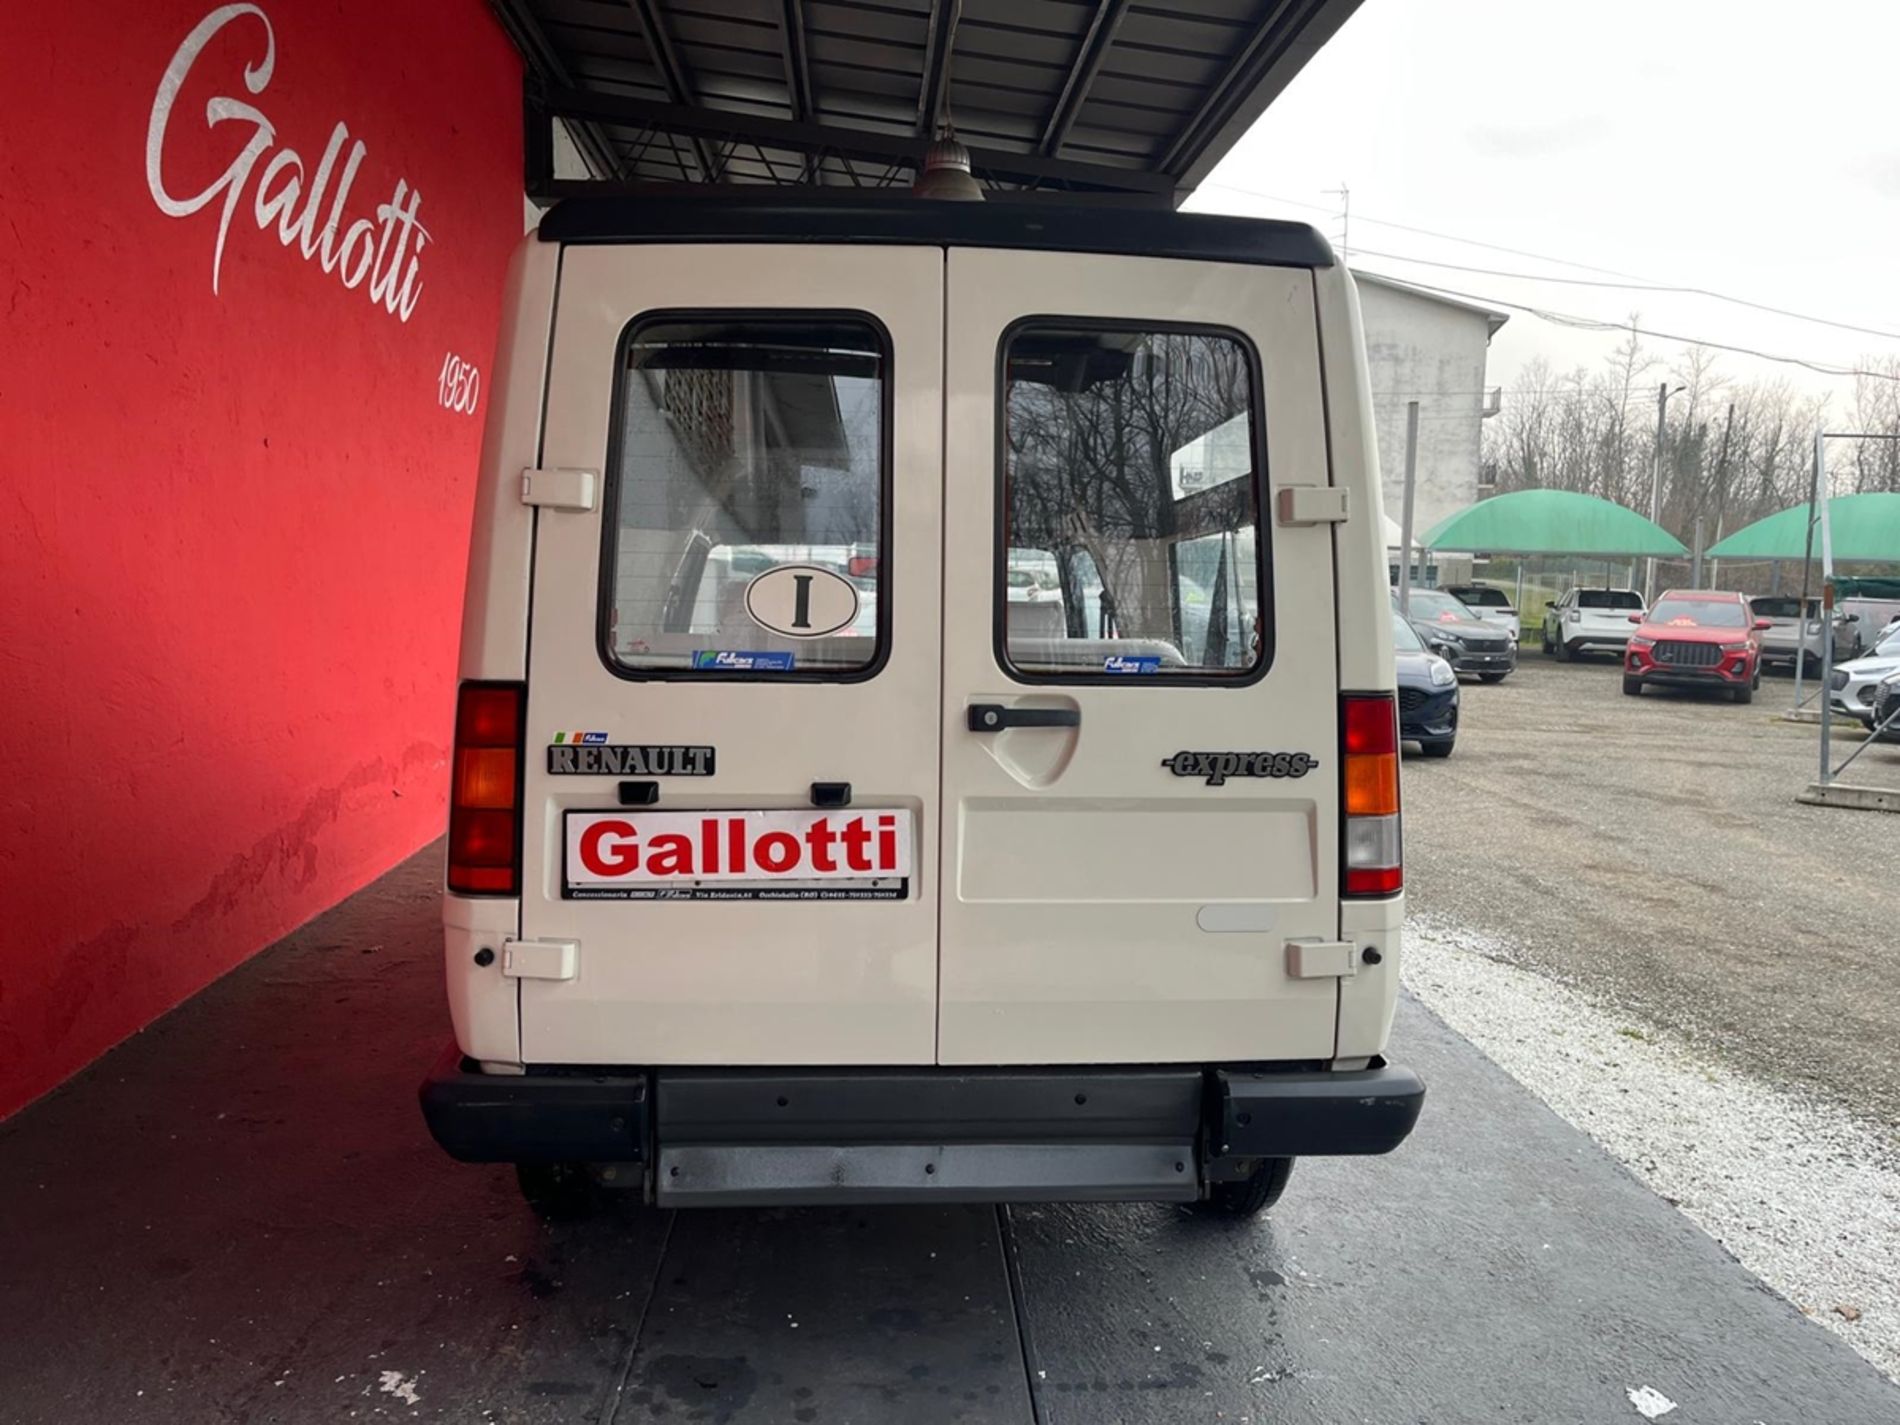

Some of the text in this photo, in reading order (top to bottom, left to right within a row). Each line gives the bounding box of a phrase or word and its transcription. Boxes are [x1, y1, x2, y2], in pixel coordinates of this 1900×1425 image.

[146, 2, 434, 322] Gallotti
[437, 351, 480, 415] 1950
[791, 575, 814, 628] I
[550, 747, 712, 774] RENAULT
[579, 815, 897, 877] Gallotti
